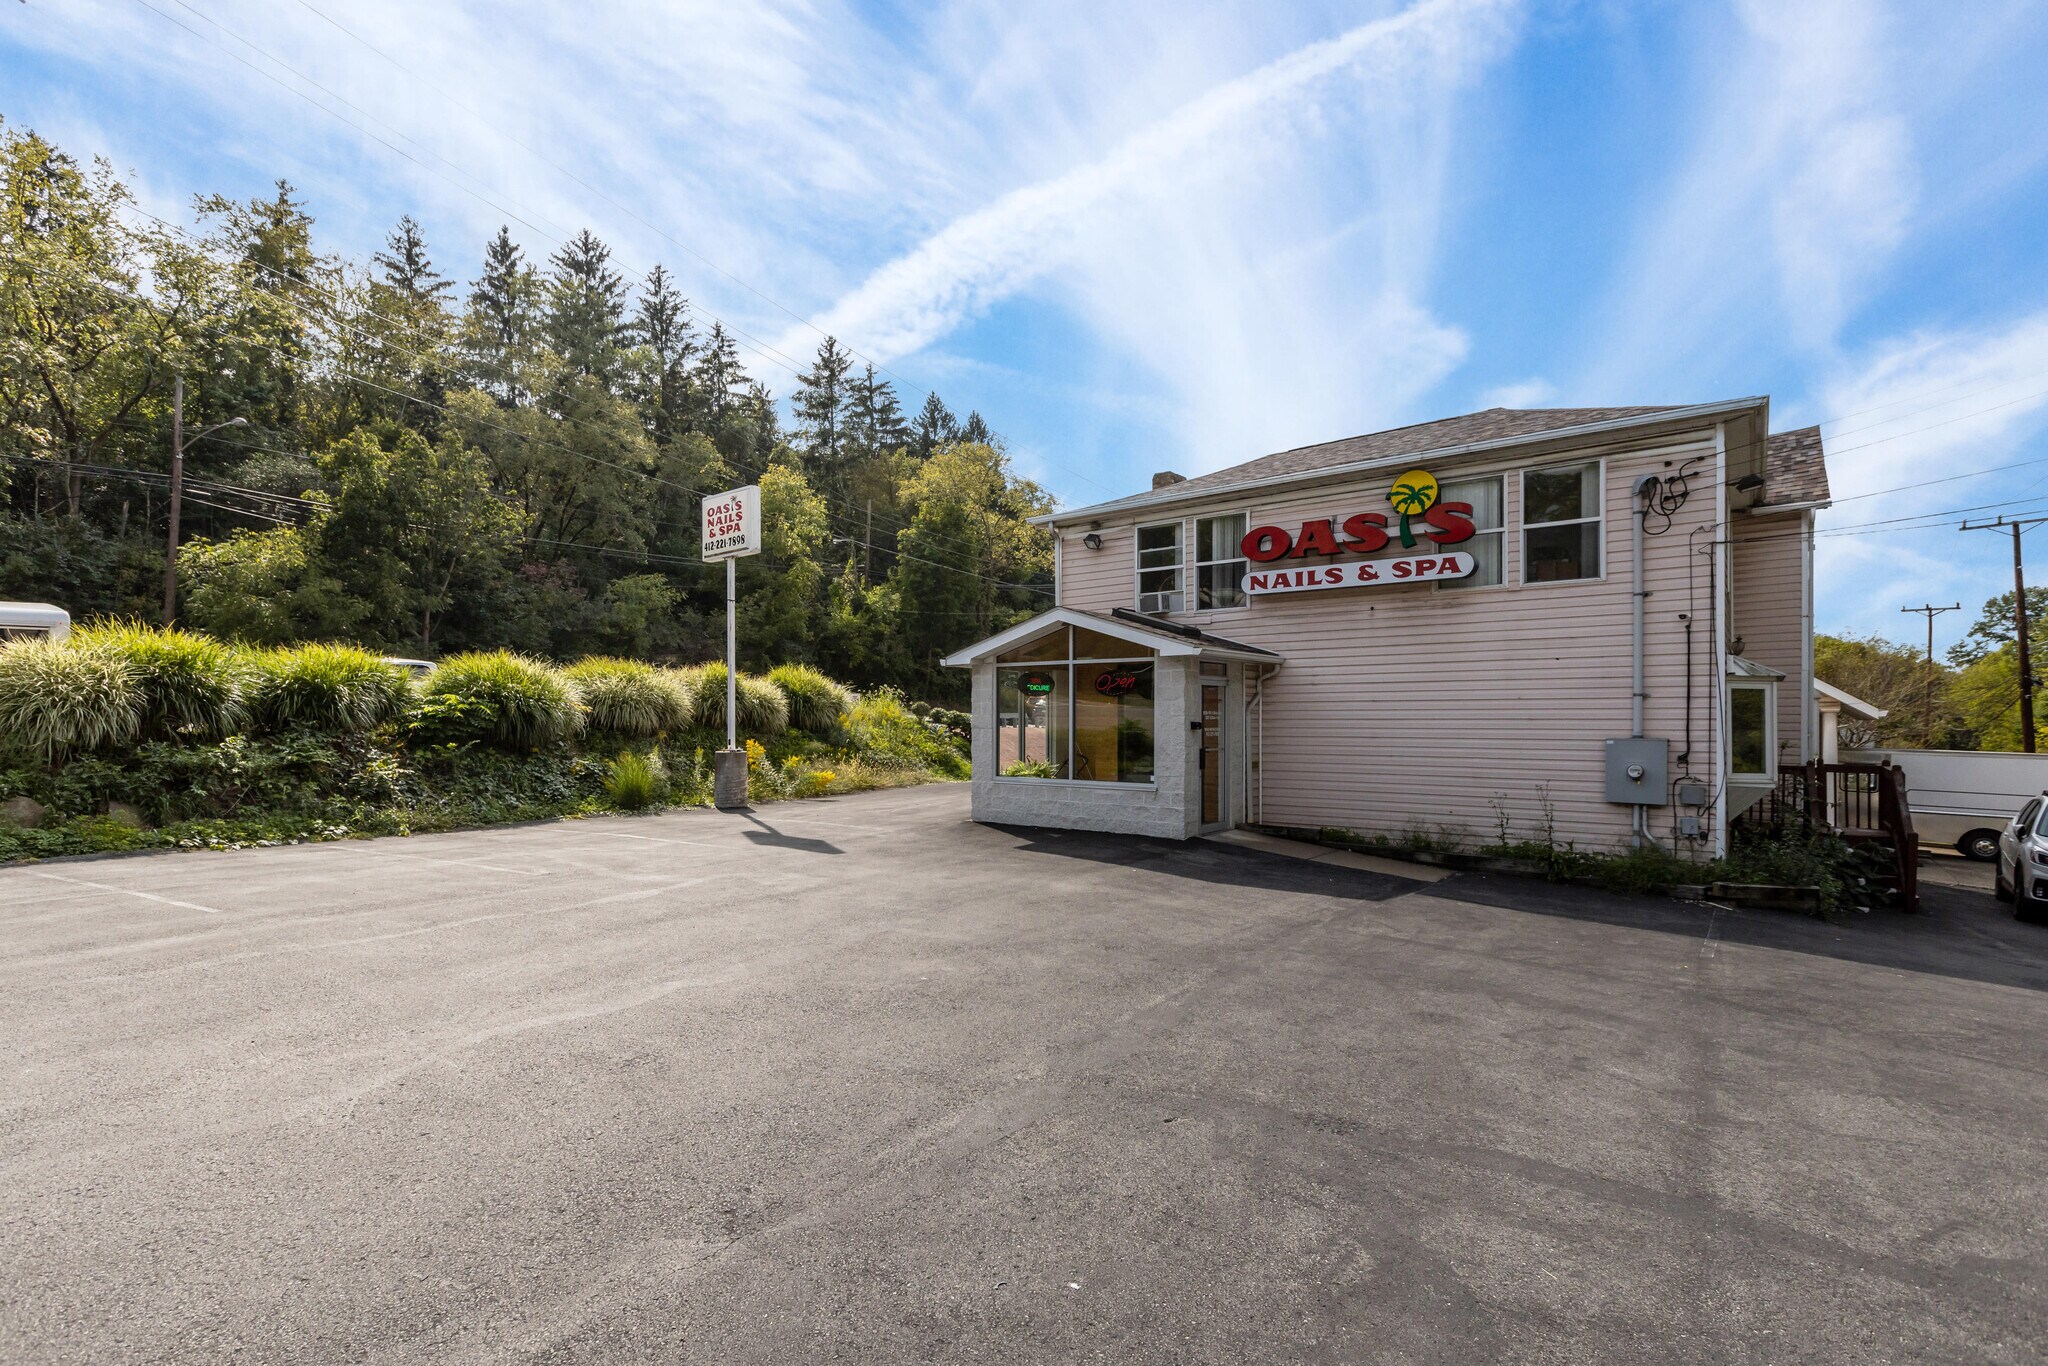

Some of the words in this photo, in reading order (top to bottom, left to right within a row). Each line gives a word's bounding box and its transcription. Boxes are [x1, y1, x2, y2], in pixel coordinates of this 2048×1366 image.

[707, 497, 742, 518] OASIS
[1241, 471, 1477, 563] OASIS
[707, 511, 743, 528] NAILS
[709, 528, 716, 539] &
[718, 522, 741, 536] SPA
[1249, 567, 1344, 591] NAILS
[1357, 564, 1380, 582] &
[1392, 556, 1462, 579] SPA
[1095, 674, 1136, 691] Open
